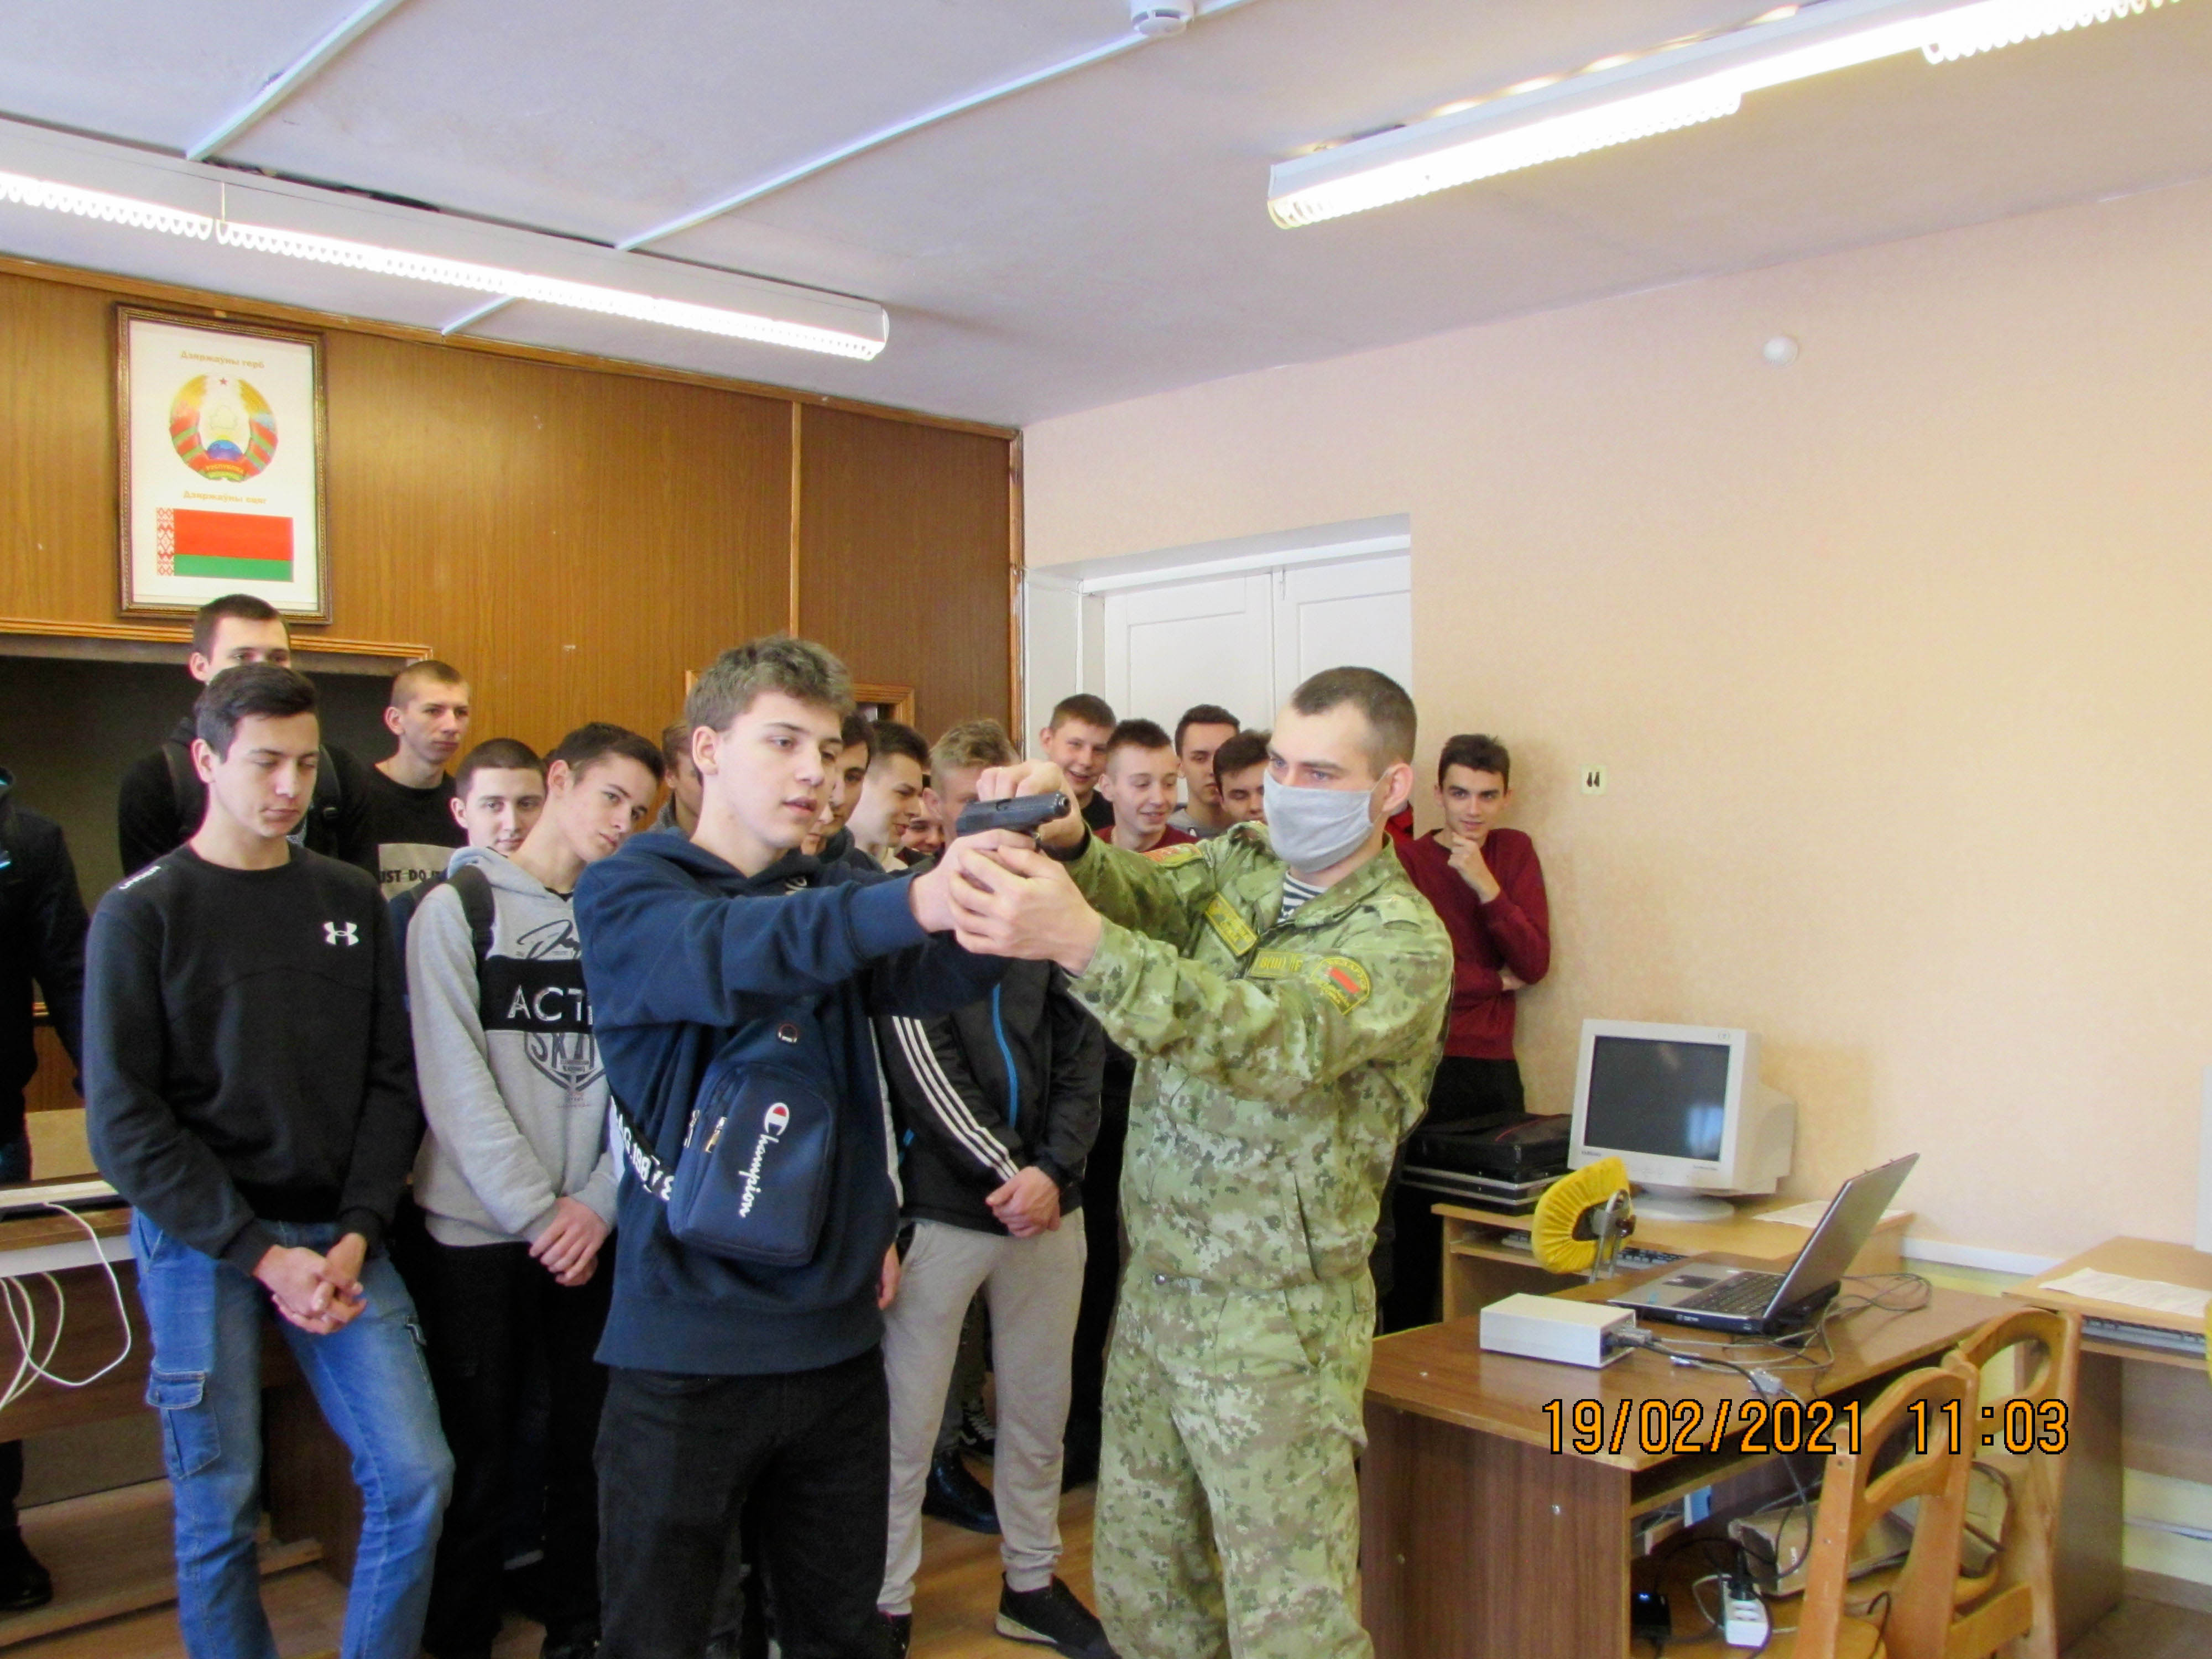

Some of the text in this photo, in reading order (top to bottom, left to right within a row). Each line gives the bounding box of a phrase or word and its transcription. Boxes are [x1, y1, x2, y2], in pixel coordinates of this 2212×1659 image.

[379, 870, 401, 883] UST
[409, 869, 427, 882] DO
[739, 1102, 790, 1218] Champion
